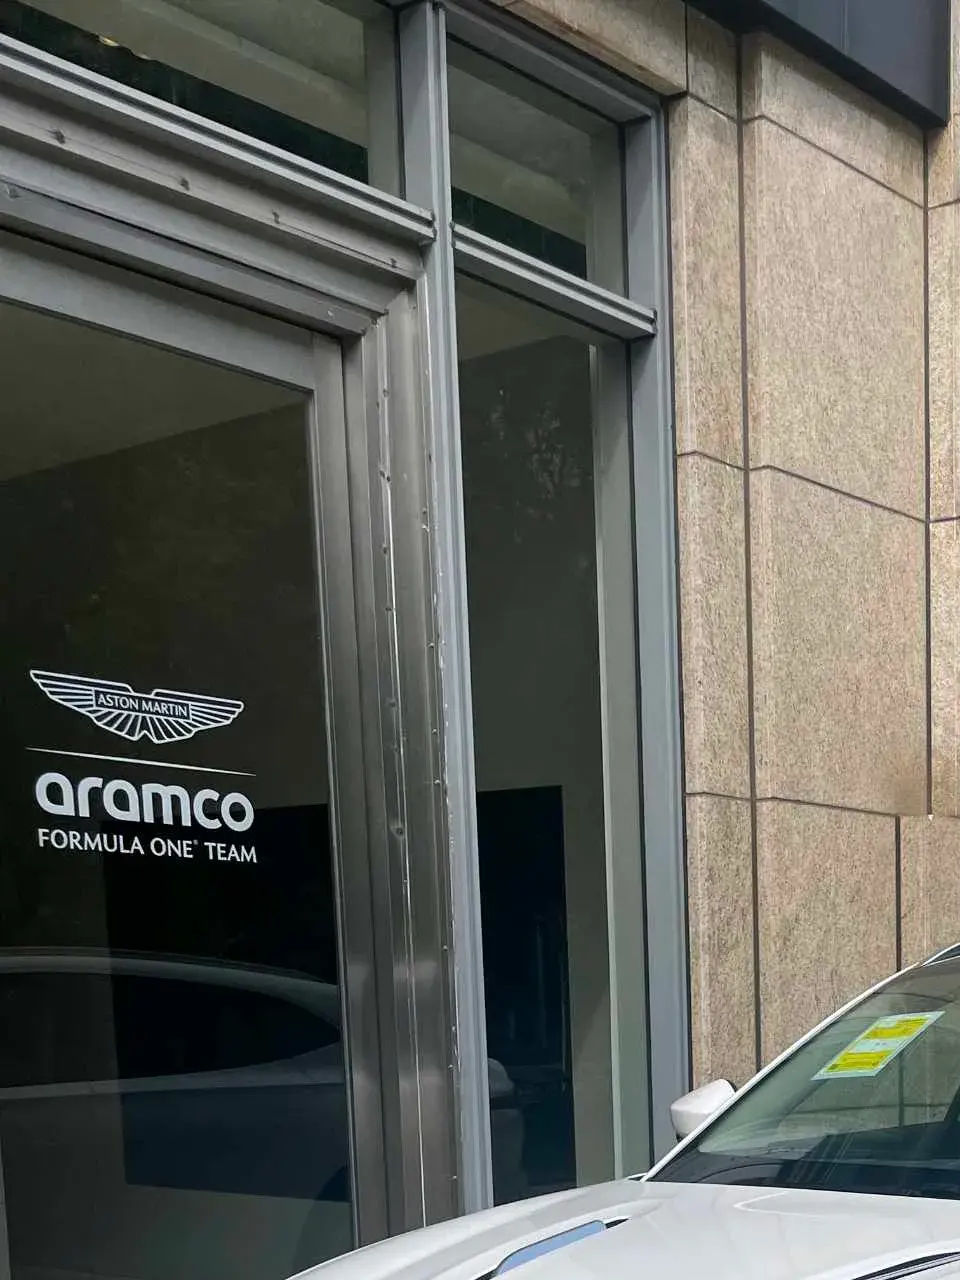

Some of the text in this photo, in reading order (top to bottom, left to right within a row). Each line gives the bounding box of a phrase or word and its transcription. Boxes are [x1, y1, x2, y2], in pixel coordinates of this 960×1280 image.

[97, 693, 188, 717] ASTON MARTIN
[35, 772, 254, 832] aramco
[38, 828, 144, 855] FORMULA
[204, 842, 257, 863] TEAM
